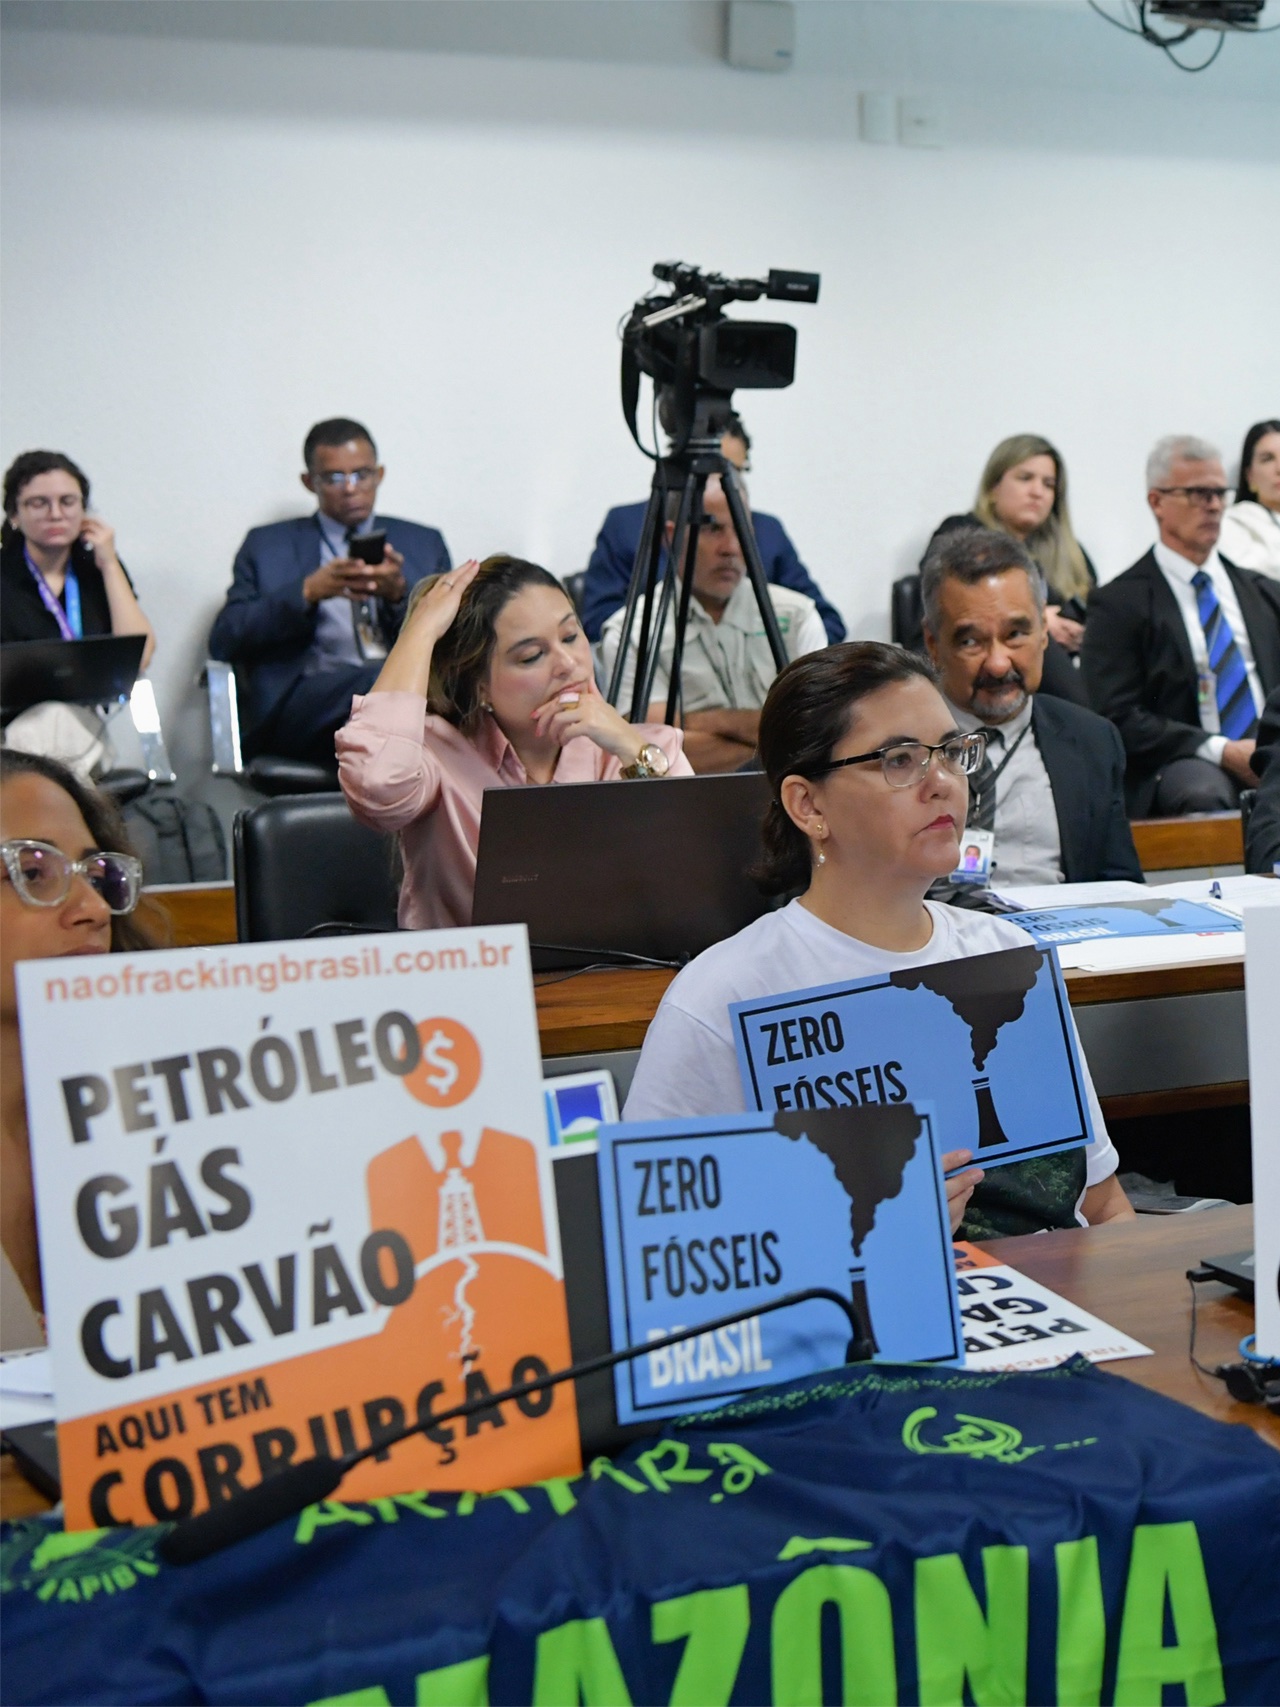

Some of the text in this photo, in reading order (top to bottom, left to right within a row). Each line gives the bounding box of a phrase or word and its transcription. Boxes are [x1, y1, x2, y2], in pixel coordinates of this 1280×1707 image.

[1038, 926, 1119, 942] BRASIL
[45, 940, 514, 1003] naofrackingbrasil.com.br
[759, 1010, 845, 1067] ZERO
[60, 1010, 423, 1145] PETRÓLEO
[75, 1137, 253, 1260] GÁS
[633, 1154, 722, 1217] ZERO
[79, 1219, 417, 1380] CARVÃO
[642, 1230, 783, 1301] FÓSSEIS
[647, 1315, 772, 1388] BRASIL
[95, 1377, 272, 1458] AQUI TEM
